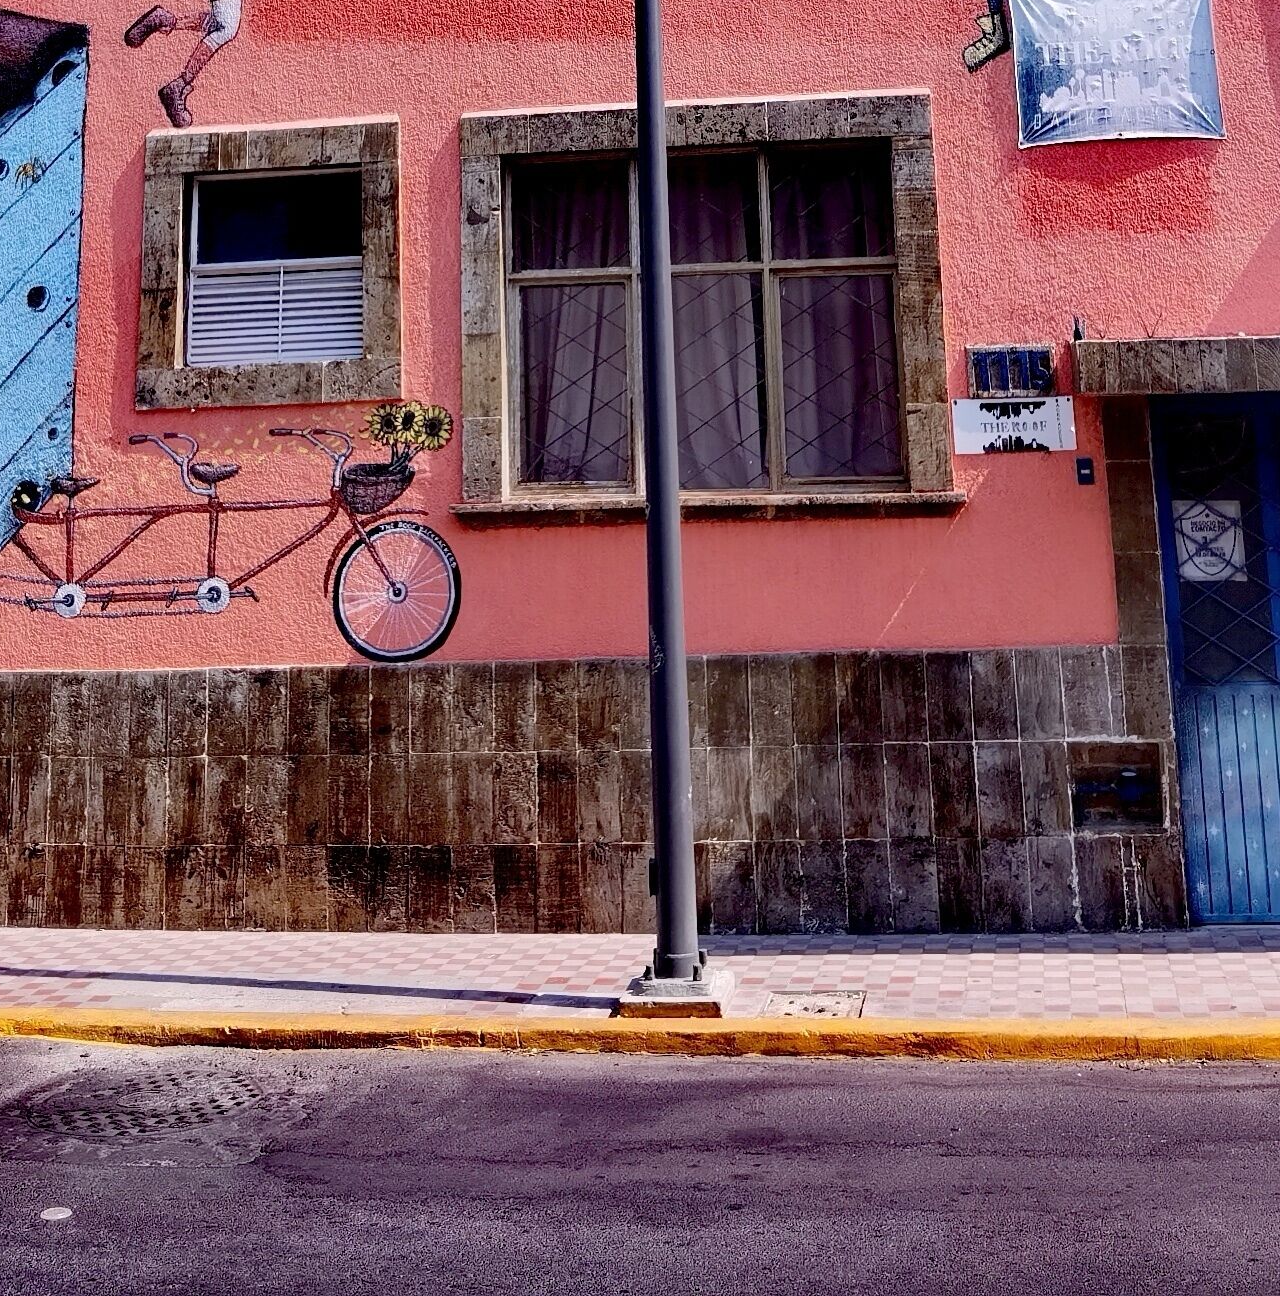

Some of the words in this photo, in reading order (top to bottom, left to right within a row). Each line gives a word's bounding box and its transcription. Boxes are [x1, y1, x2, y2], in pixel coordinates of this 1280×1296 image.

[1034, 40, 1105, 67] THE
[980, 422, 1010, 433] THE
[379, 522, 395, 531] THE
